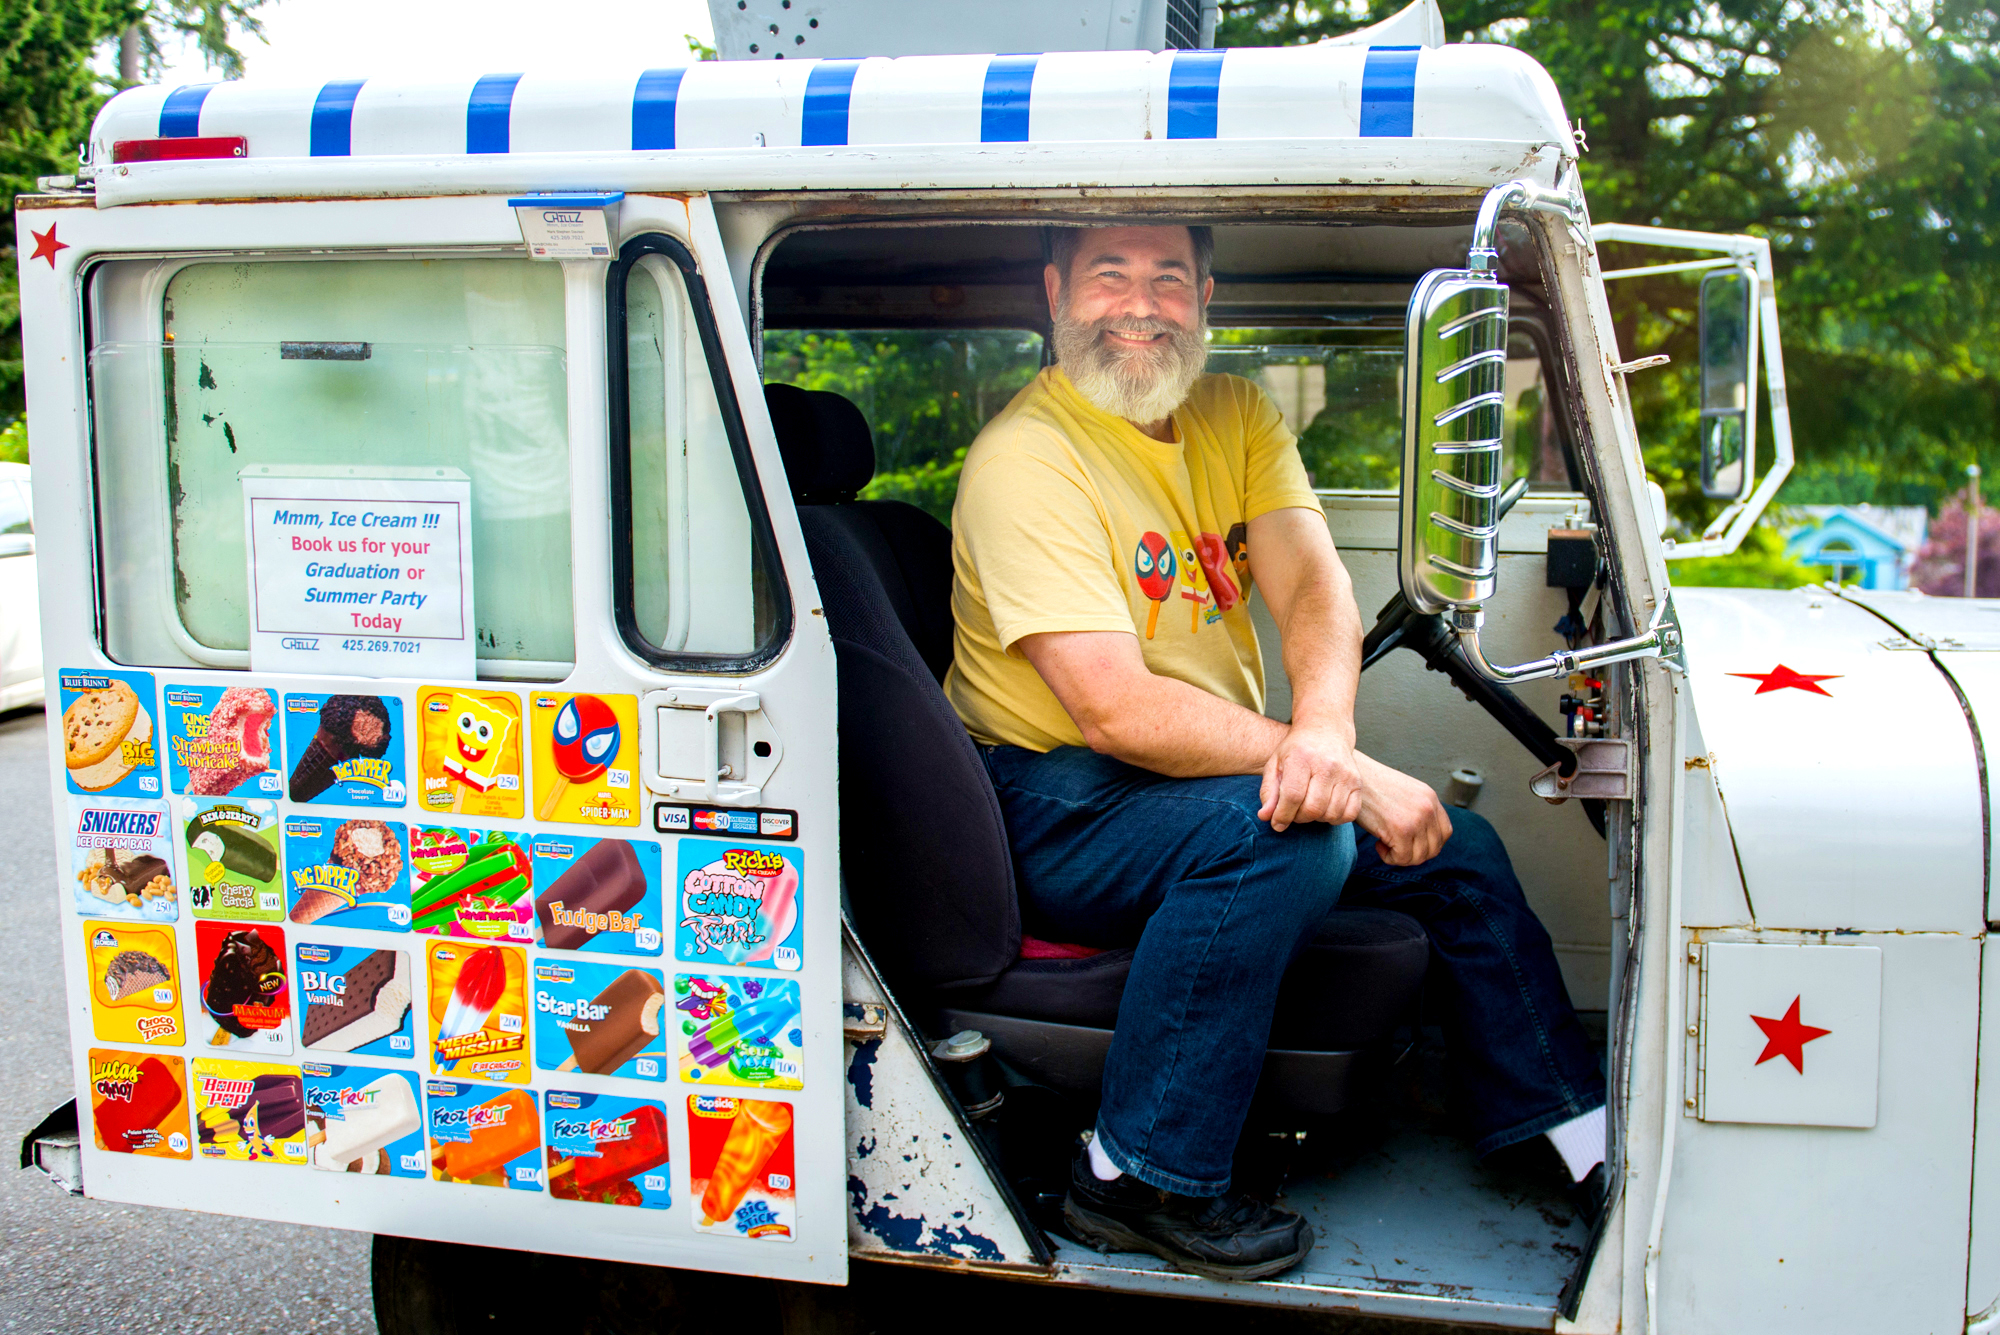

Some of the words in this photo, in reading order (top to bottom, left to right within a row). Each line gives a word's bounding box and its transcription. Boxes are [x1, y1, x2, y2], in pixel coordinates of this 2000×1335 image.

[543, 211, 584, 223] CHILLZ
[273, 510, 324, 529] Mmm,
[329, 511, 357, 527] Ice
[362, 512, 417, 528] Cream
[422, 513, 440, 529] !!!
[291, 536, 333, 552] Book
[338, 540, 357, 553] us
[362, 537, 386, 553] for
[391, 541, 430, 557] your
[305, 562, 400, 580] Graduation
[407, 567, 425, 580] or
[304, 587, 377, 605] Summer
[380, 590, 427, 610] Party
[351, 613, 402, 633] Today
[281, 637, 320, 651] CHILLZ
[342, 640, 421, 653] 425.269.7021
[64, 678, 82, 687] BLUE
[83, 678, 108, 687] BUNNY
[536, 698, 556, 706] Popsicle
[182, 712, 211, 726] KING
[186, 724, 208, 738] SIZE
[171, 735, 241, 756] Strawberry
[123, 756, 155, 767] BOPPER
[177, 750, 239, 769] Shortcake
[425, 777, 448, 791] NICK
[581, 806, 630, 819] SPIDER-MAN
[662, 813, 687, 823] VISA
[81, 811, 158, 835] SNICKERS
[77, 836, 92, 848] ICE
[94, 836, 128, 850] CREAM
[129, 838, 151, 851] BAR
[724, 850, 784, 878] Rich's
[219, 882, 255, 897] Cherry
[684, 869, 765, 899] COTTON
[222, 895, 255, 908] Garcia
[688, 893, 763, 920] CANDY
[549, 901, 608, 935] Fudge
[607, 911, 644, 934] Bar
[259, 978, 280, 993] NEW
[301, 971, 347, 995] BIG
[306, 992, 344, 1007] Vanilla
[536, 991, 576, 1017] Star
[576, 998, 609, 1020] Bar
[234, 1005, 285, 1019] MAGNUM
[138, 1016, 173, 1031] CHOCO
[556, 1020, 591, 1032] VANILLA
[144, 1027, 171, 1040] TACO
[437, 1031, 487, 1050] MEGA
[444, 1035, 522, 1060] MISSILE
[739, 1043, 772, 1057] Sour
[91, 1057, 144, 1085] Lucas
[203, 1078, 254, 1094] BOMB
[207, 1092, 247, 1107] POP
[696, 1096, 734, 1110] Popsicle
